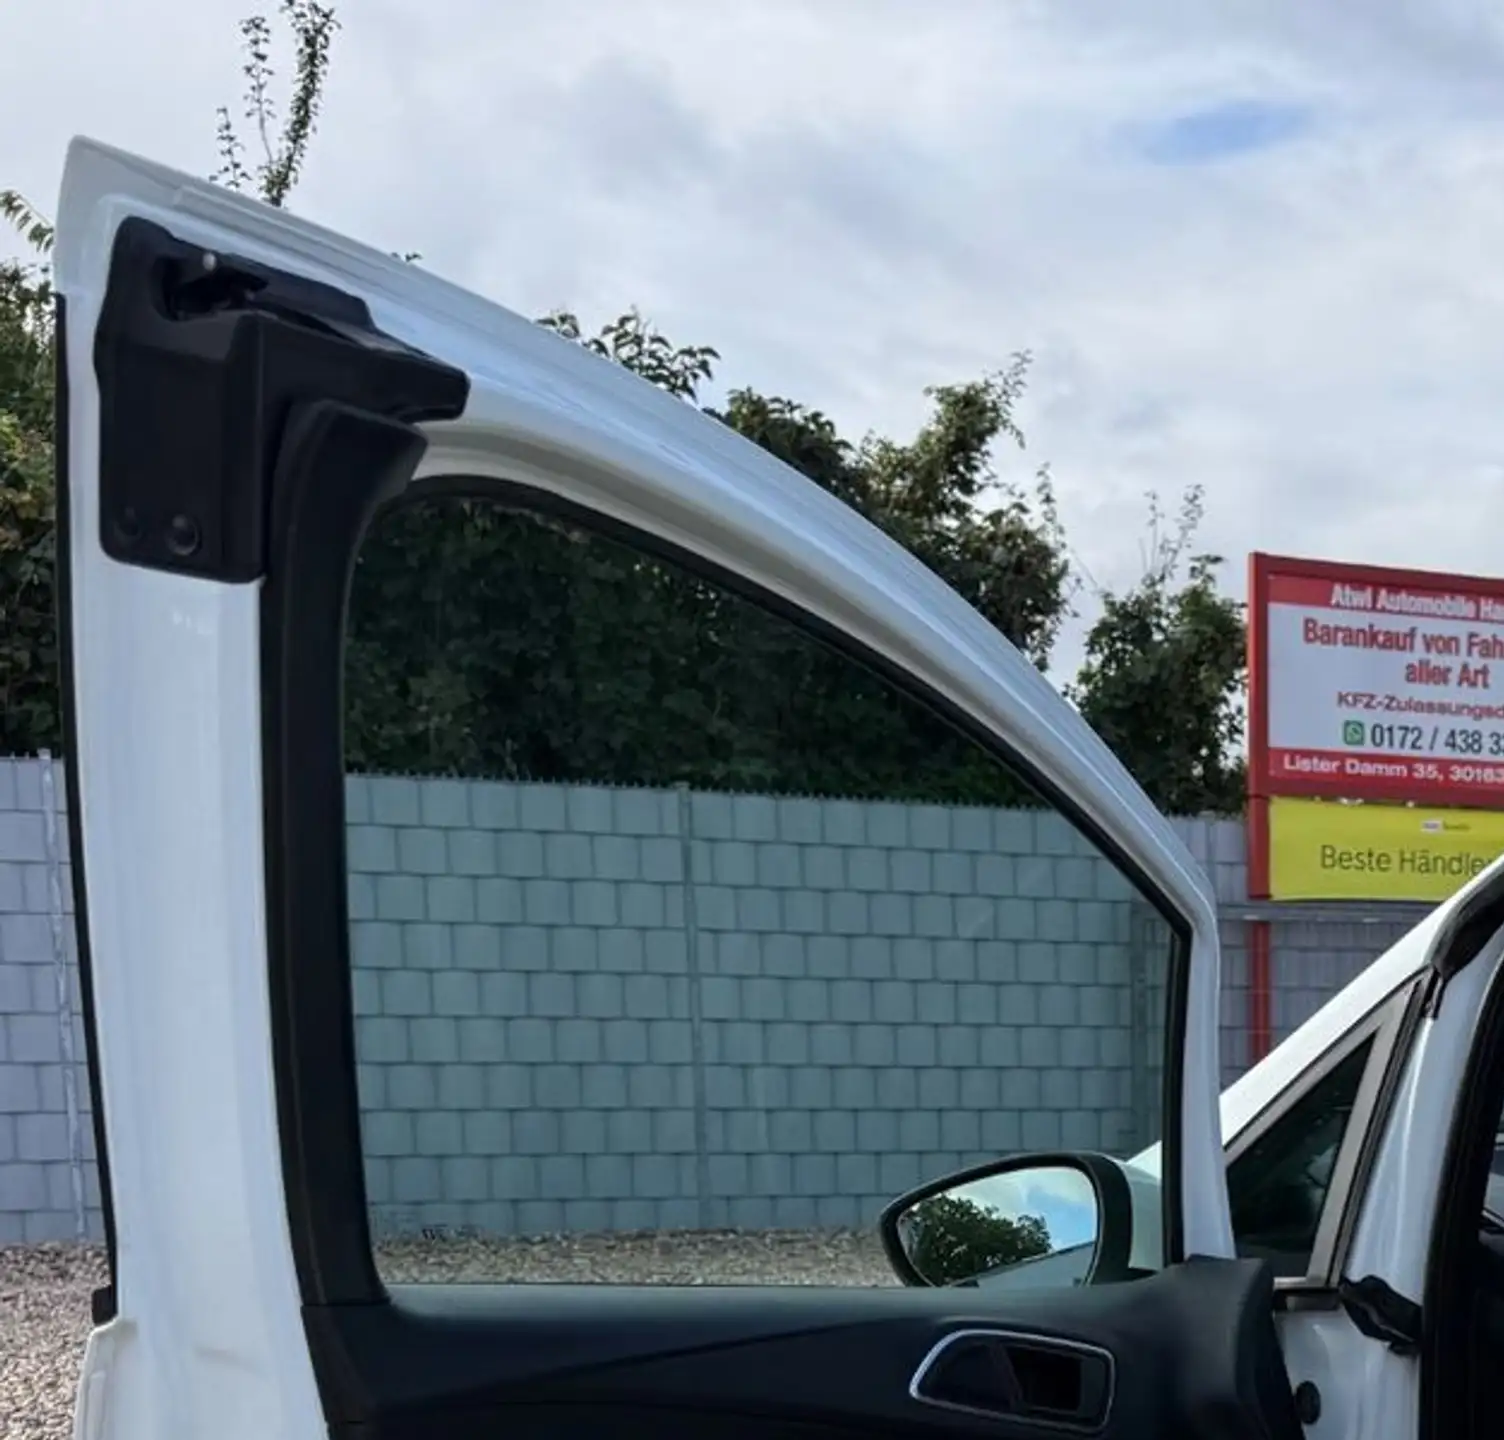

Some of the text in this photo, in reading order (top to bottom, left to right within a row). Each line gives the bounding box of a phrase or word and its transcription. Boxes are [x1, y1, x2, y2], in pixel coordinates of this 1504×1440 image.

[1377, 588, 1477, 618] Automobile
[1302, 617, 1416, 653] Barankauf
[1421, 632, 1460, 657] von
[1405, 660, 1491, 689] aller Art
[1371, 725, 1423, 750] 0172
[1429, 726, 1438, 749] /
[1444, 728, 1482, 755] 438
[1283, 754, 1339, 774] Lister
[1344, 759, 1408, 777] Damm
[1412, 763, 1444, 782] 35,
[1320, 844, 1392, 871] Beste
